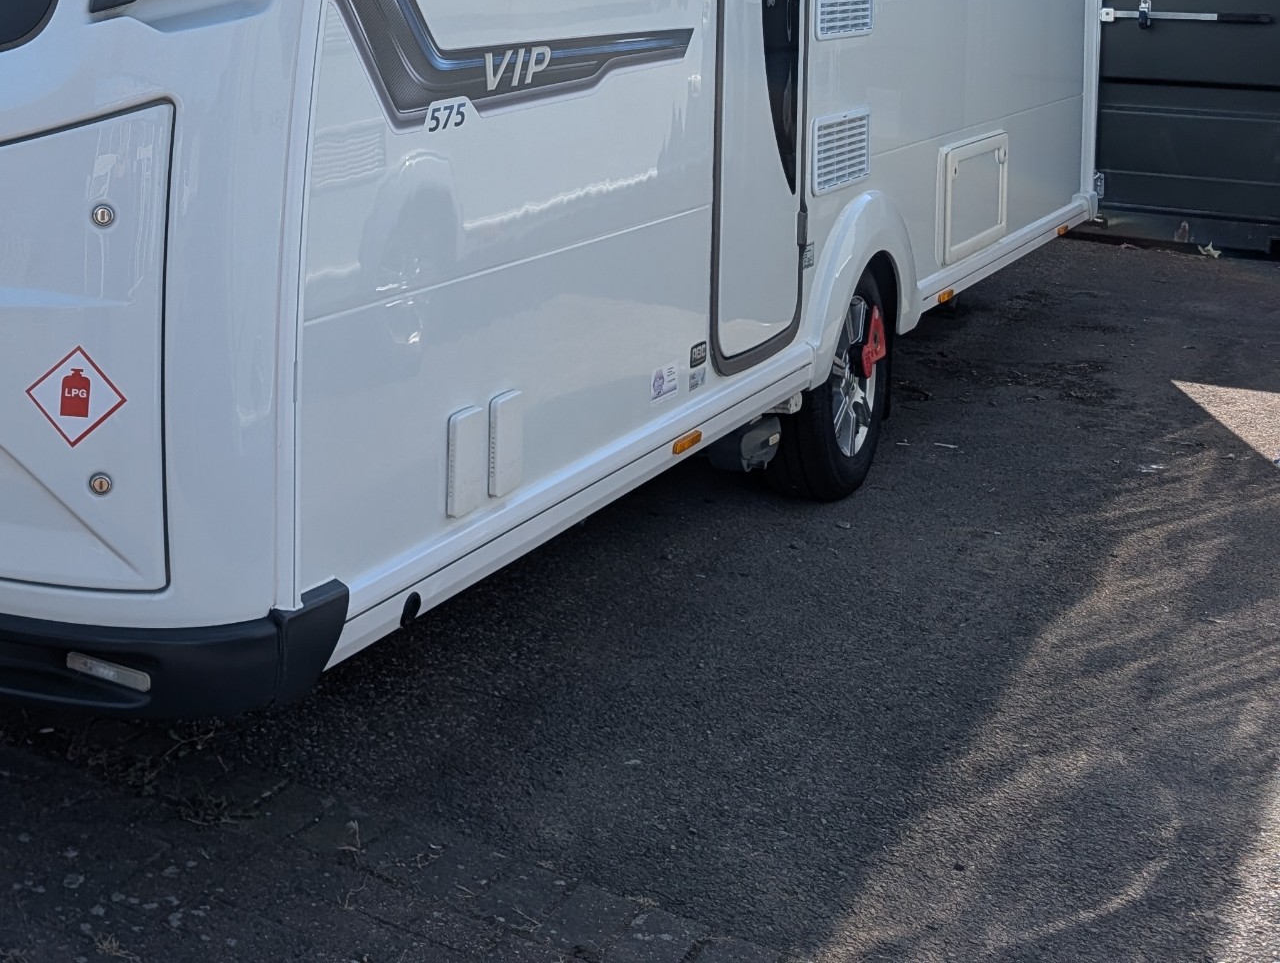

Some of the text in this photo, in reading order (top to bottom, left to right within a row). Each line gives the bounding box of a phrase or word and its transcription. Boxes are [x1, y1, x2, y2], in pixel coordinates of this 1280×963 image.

[484, 45, 551, 91] VIP
[428, 102, 467, 133] 575
[64, 387, 87, 398] LPG
